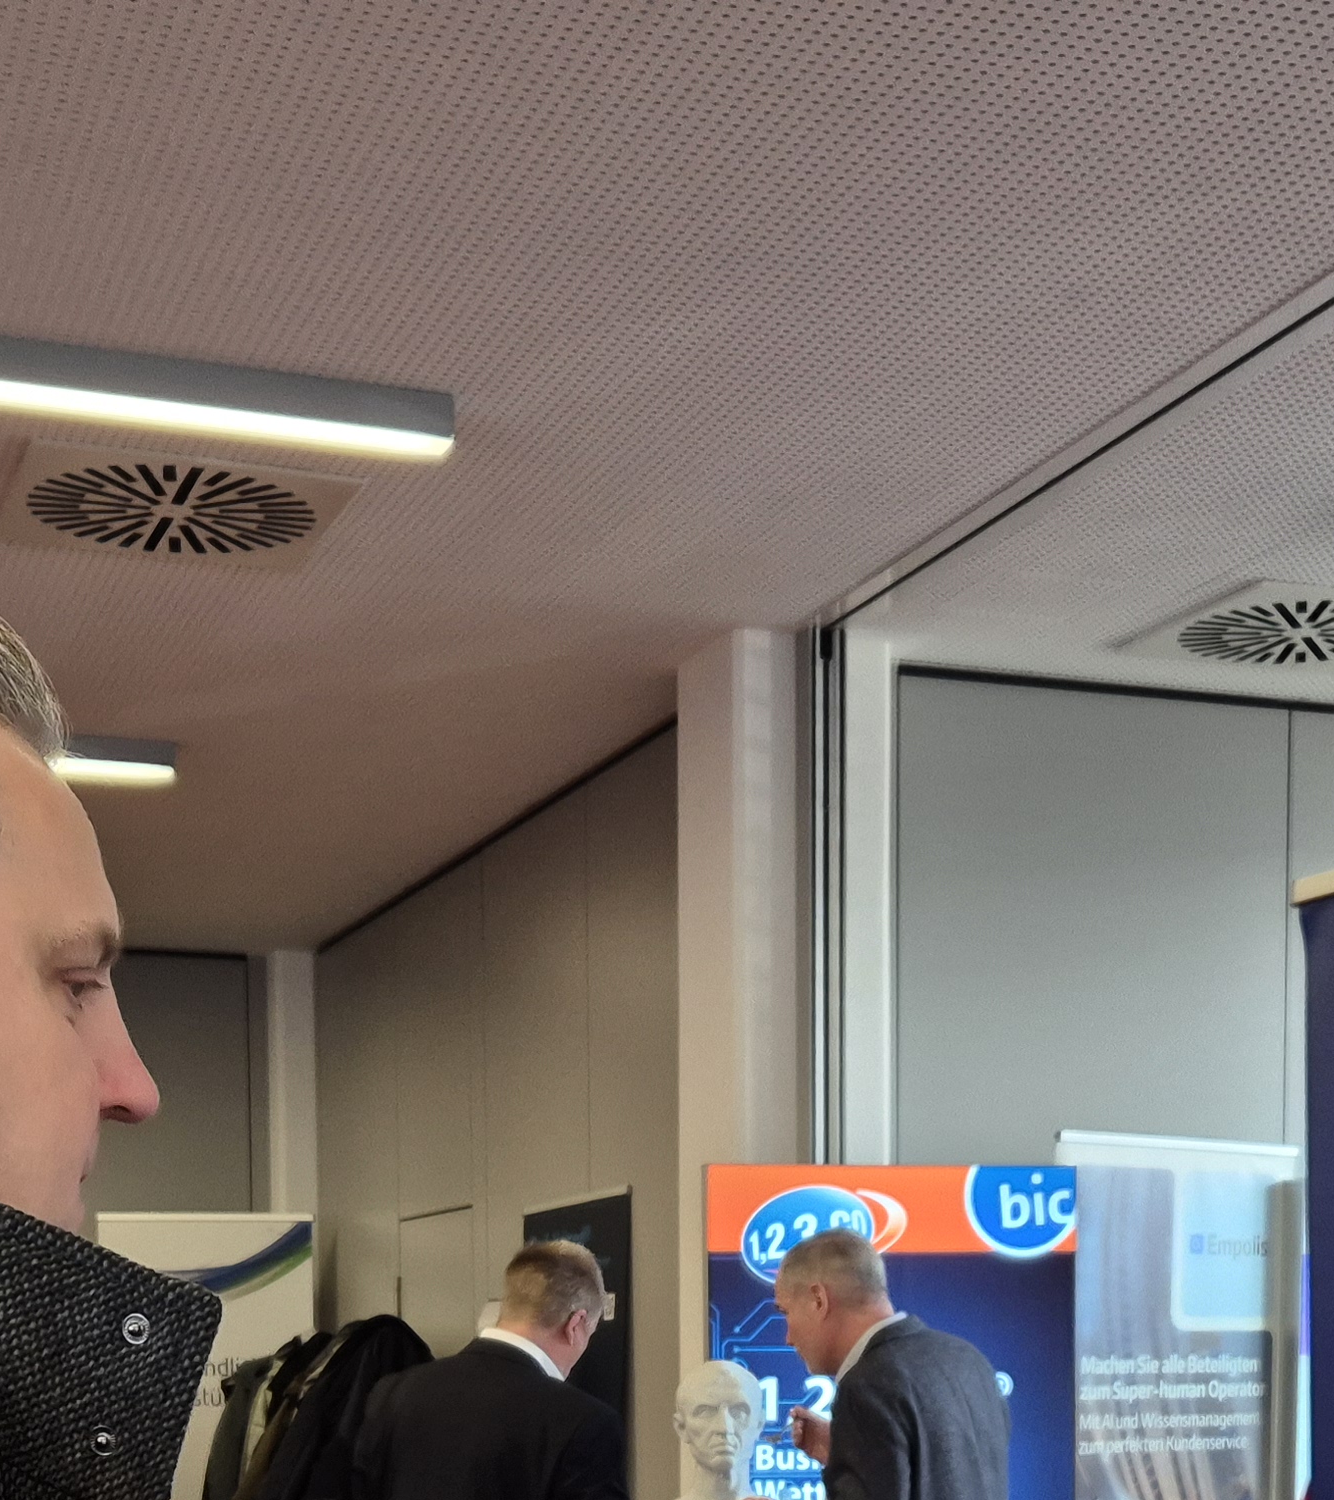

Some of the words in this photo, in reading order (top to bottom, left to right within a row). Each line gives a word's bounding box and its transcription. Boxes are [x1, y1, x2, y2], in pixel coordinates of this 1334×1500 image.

[998, 1172, 1075, 1229] bic
[1207, 1233, 1267, 1260] Empolis
[204, 1357, 240, 1377] ndli
[1081, 1355, 1135, 1375] Machen
[1136, 1353, 1159, 1374] Sie
[1162, 1354, 1185, 1373] alle
[1187, 1353, 1258, 1376] Beteiligten
[1079, 1386, 1111, 1400] zum
[1079, 1414, 1101, 1430] Mit
[1117, 1413, 1138, 1429] und
[1078, 1440, 1107, 1456] zum
[1166, 1433, 1249, 1452] Kundenservice
